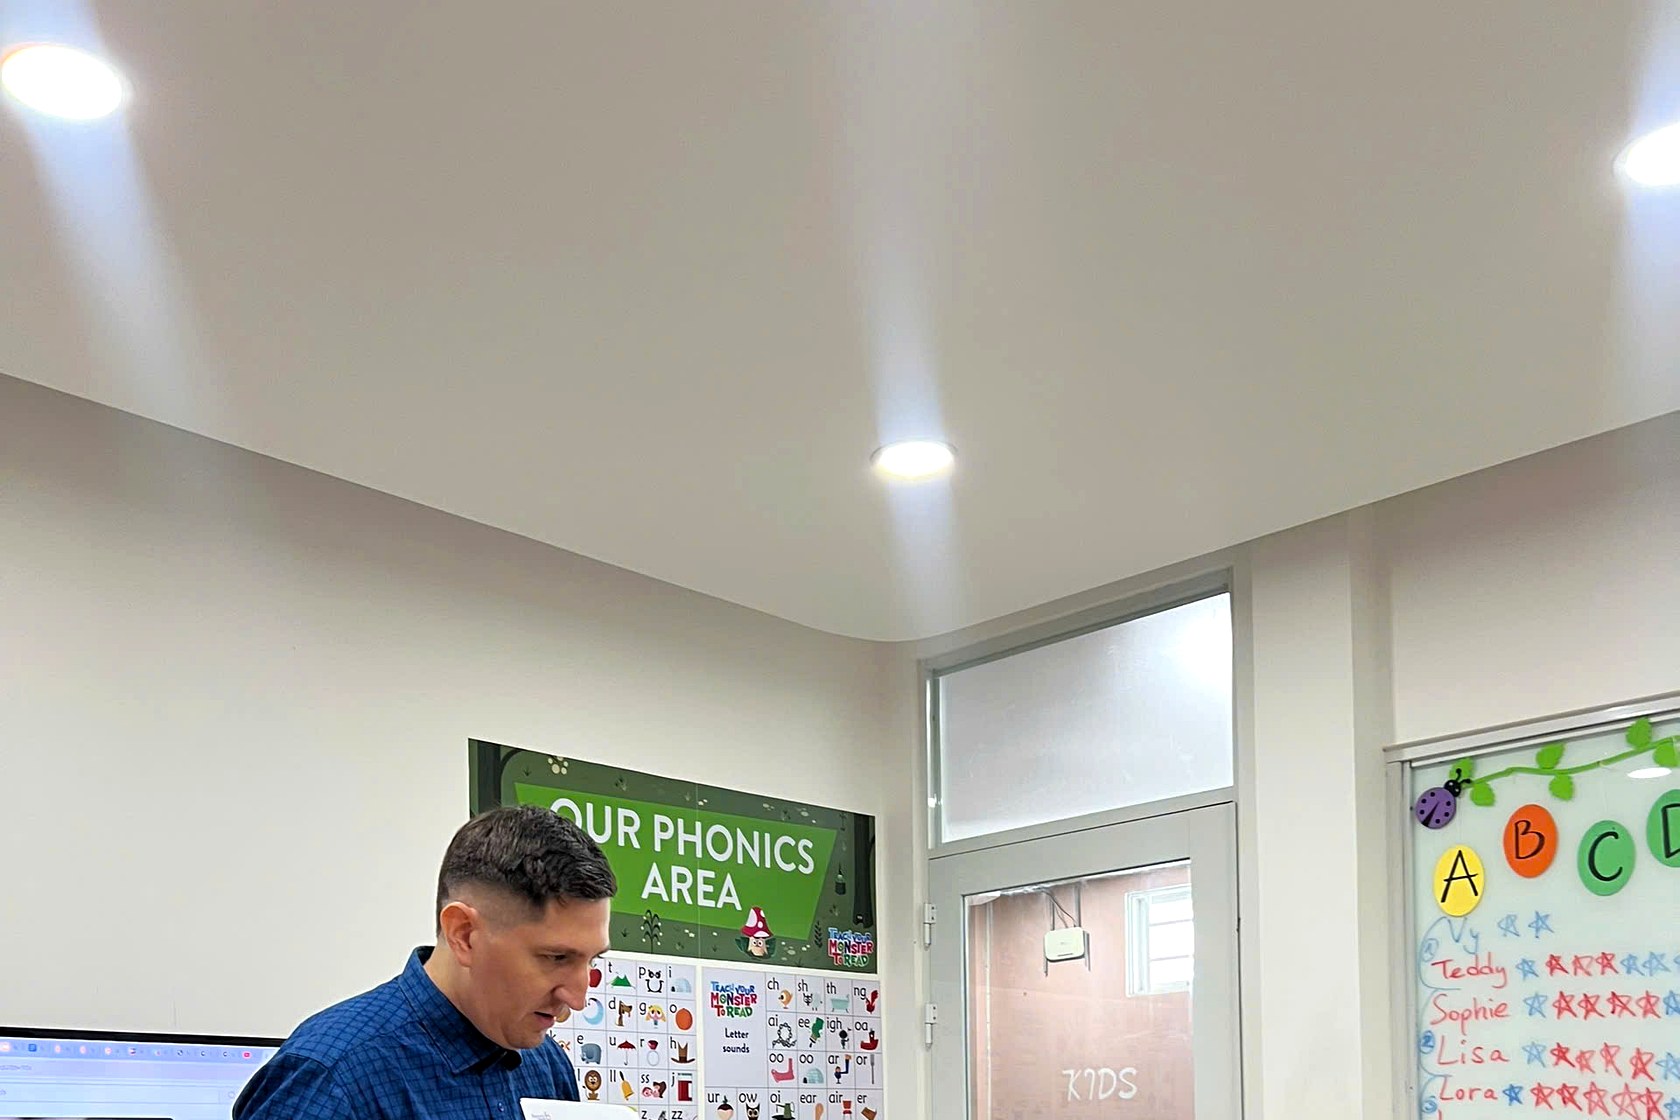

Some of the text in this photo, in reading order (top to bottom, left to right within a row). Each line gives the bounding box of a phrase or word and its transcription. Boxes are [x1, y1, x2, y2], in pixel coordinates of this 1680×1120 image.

[550, 797, 815, 875] OUR PHONICS
[1513, 819, 1546, 860] B
[1588, 831, 1623, 881] C
[1439, 849, 1479, 903] A
[641, 861, 743, 911] AREA
[828, 938, 874, 956] MONSTER
[843, 954, 869, 968] READ
[1431, 951, 1508, 989] Teddy
[638, 966, 646, 979] p
[710, 981, 734, 993] TEACH
[767, 977, 866, 1000] ch sh th ng
[608, 997, 677, 1015] d g o
[711, 992, 758, 1008] MONSTER
[726, 1005, 753, 1018] READ
[1430, 993, 1511, 1036] Sophie
[725, 1027, 749, 1038] Letter
[768, 1015, 868, 1033] ai ee igh oa
[576, 1034, 584, 1045] e
[609, 1036, 616, 1046] u
[640, 1037, 645, 1047] r
[669, 1037, 677, 1049] h
[723, 1043, 750, 1053] sounds
[1437, 1035, 1509, 1065] Lisa
[769, 1053, 867, 1065] oo oo ar or
[640, 1073, 650, 1084] ss
[1062, 1067, 1138, 1101] KIDS
[1440, 1075, 1498, 1101] Lora
[707, 1091, 867, 1104] ur ow oi ear air er
[641, 1110, 683, 1120] z zz
